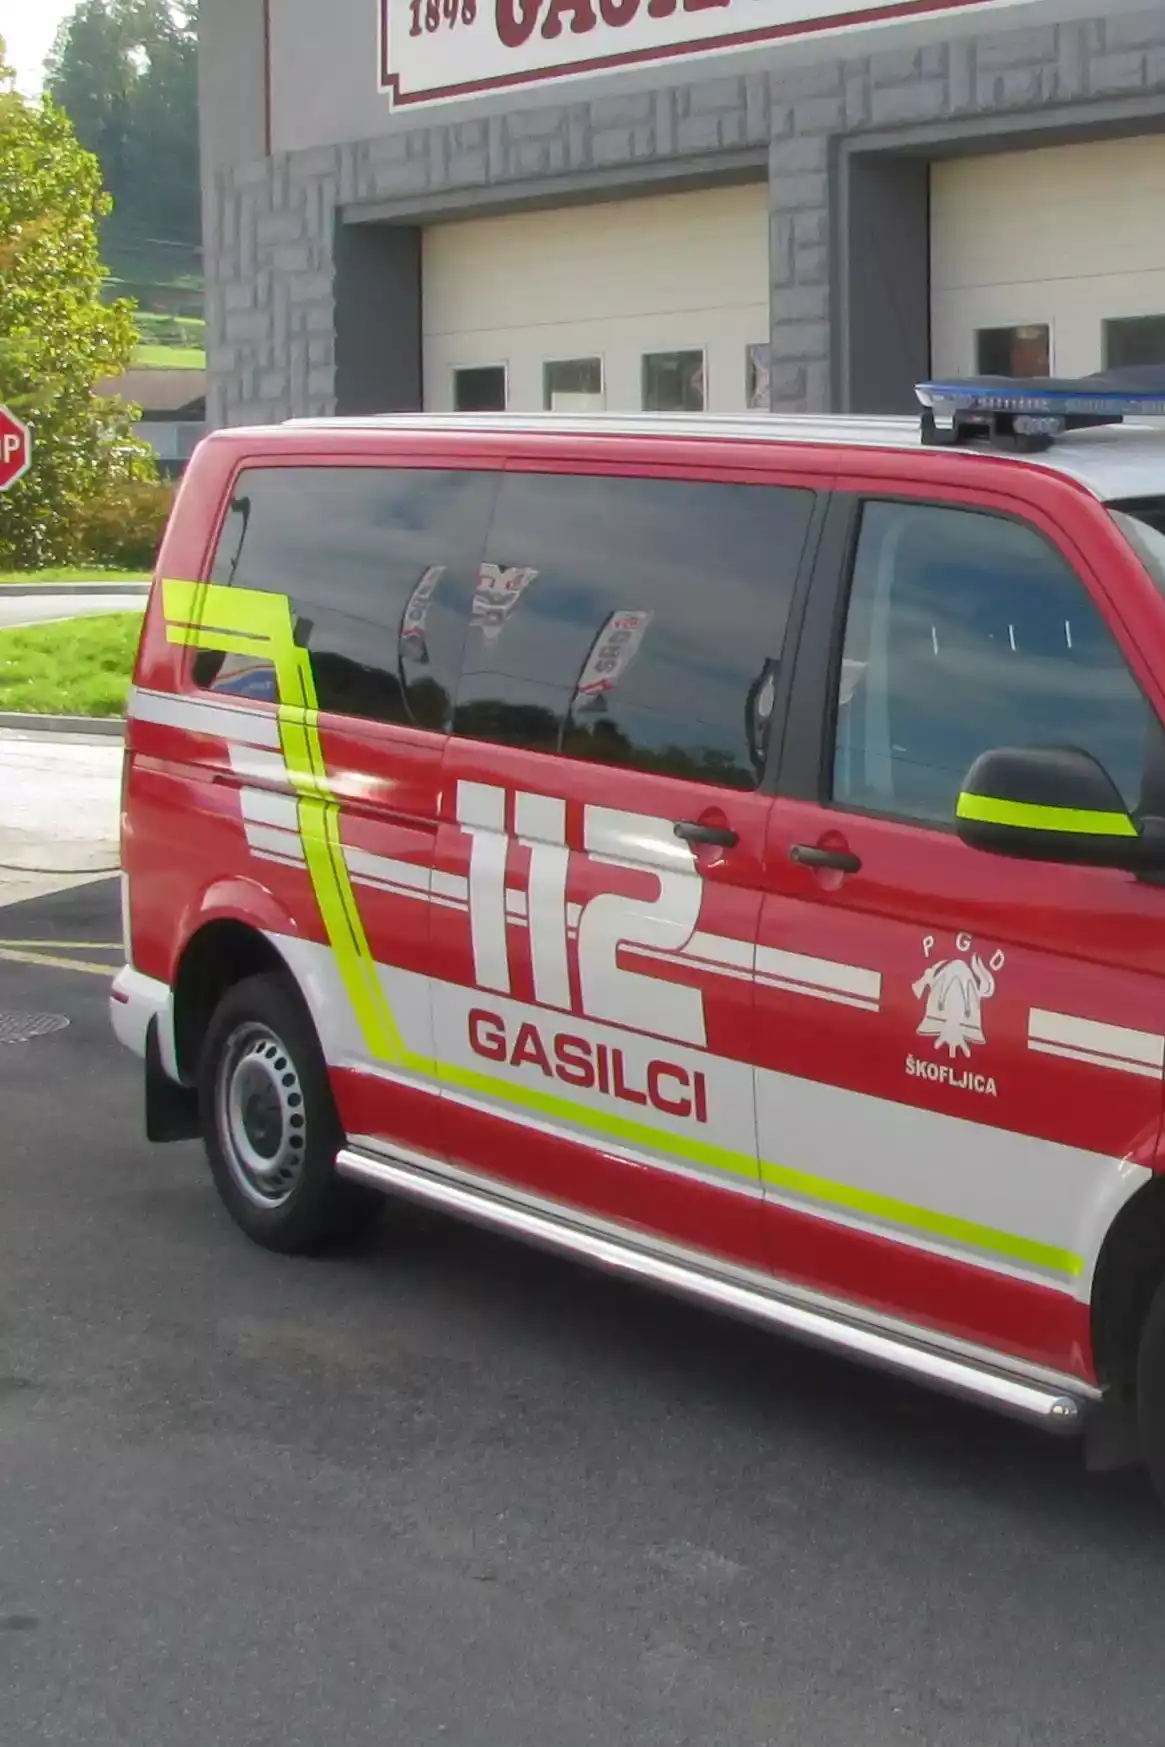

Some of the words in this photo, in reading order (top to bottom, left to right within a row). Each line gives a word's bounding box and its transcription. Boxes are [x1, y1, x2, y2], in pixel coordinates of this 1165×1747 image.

[456, 779, 709, 1049] 112
[468, 1008, 709, 1123] GASILCI
[905, 1053, 998, 1097] ŠKOFLJICA
